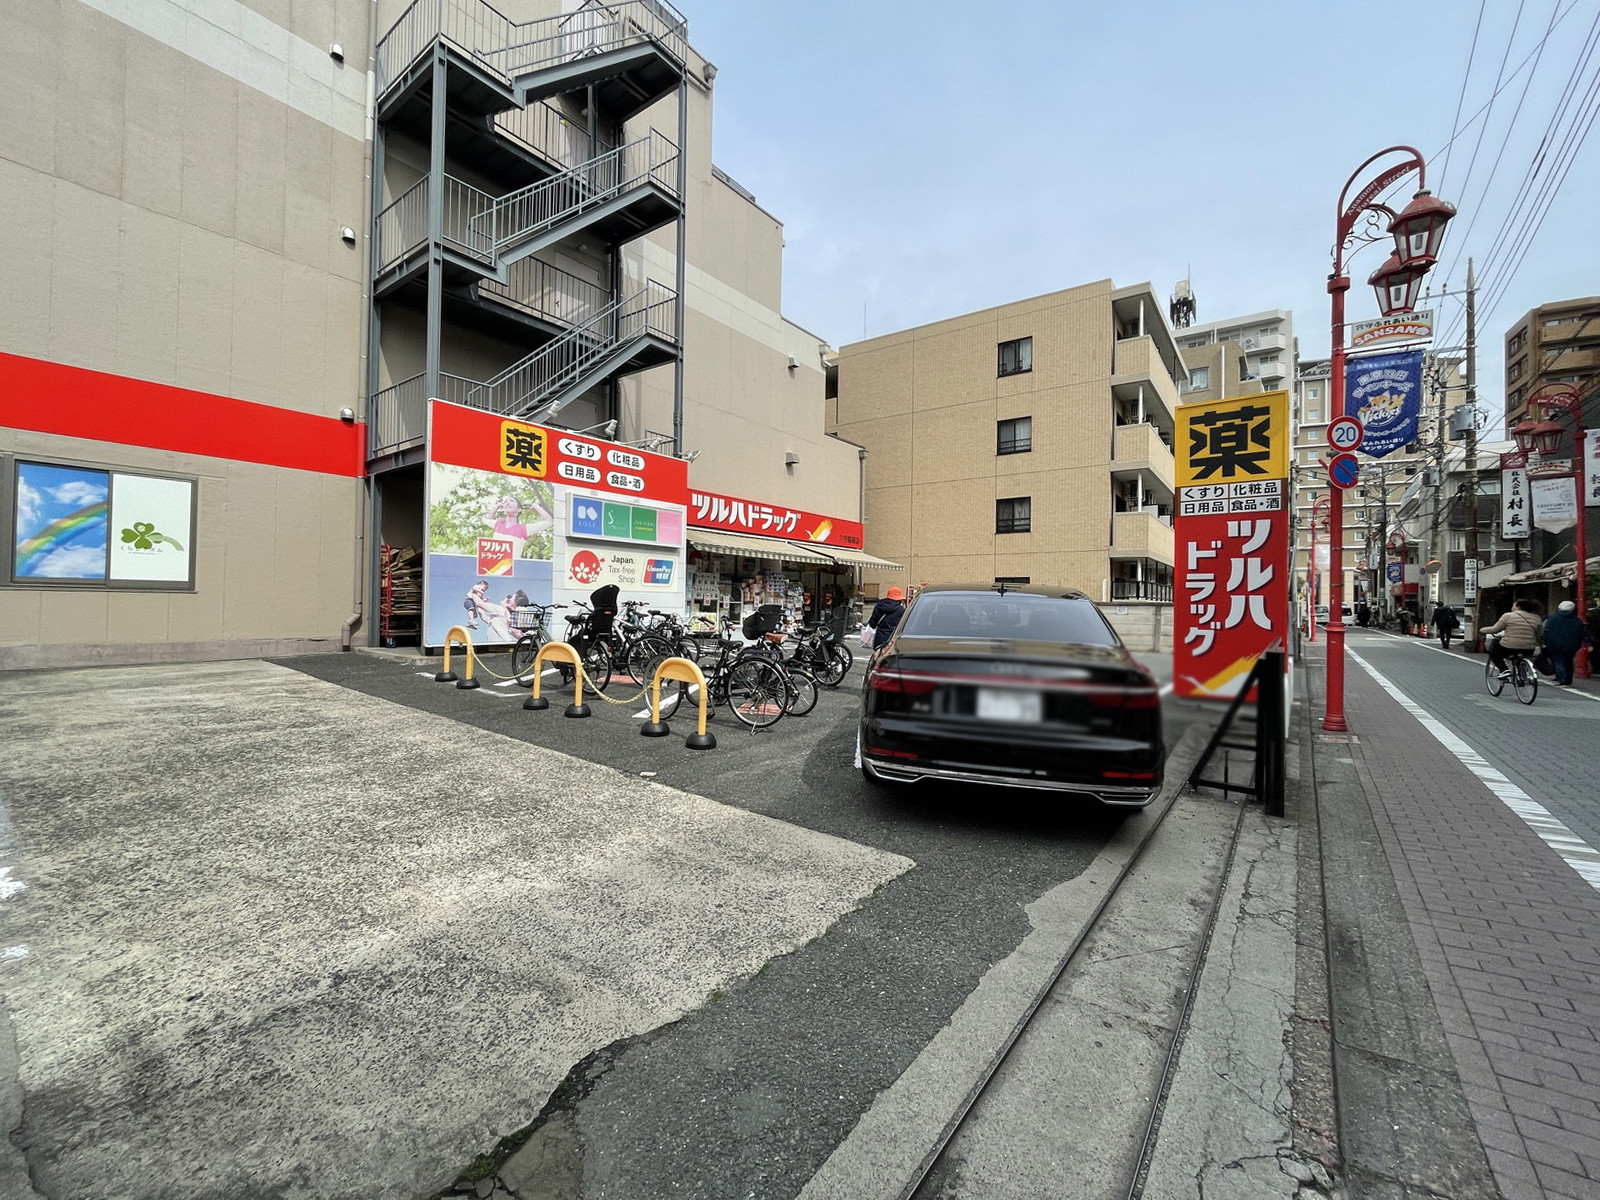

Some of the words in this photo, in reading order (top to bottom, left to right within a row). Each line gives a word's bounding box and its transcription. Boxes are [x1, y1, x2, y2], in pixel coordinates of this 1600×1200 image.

[1382, 165, 1410, 188] Street
[1189, 405, 1270, 480] 薬
[1335, 426, 1357, 442] 20
[1361, 437, 1404, 447] 守ふれあい通り
[506, 428, 542, 472] 薬
[564, 441, 595, 458] くすり
[612, 452, 640, 468] 化粧品
[564, 464, 595, 481] 日用品
[611, 473, 641, 489] 食品・酒
[1184, 485, 1225, 499] くすり
[1233, 482, 1278, 496] 化粧品
[691, 493, 802, 533] ツルハドラッグ
[1184, 501, 1225, 514] 日用品
[1231, 497, 1280, 512] 食品・酒
[481, 541, 511, 553] ツルハ
[608, 565, 636, 574] Tax-free
[647, 564, 672, 574] UnionPay
[1226, 519, 1272, 630] ツルハ
[618, 575, 636, 584] Shop
[1184, 540, 1222, 657] ドラッグ
